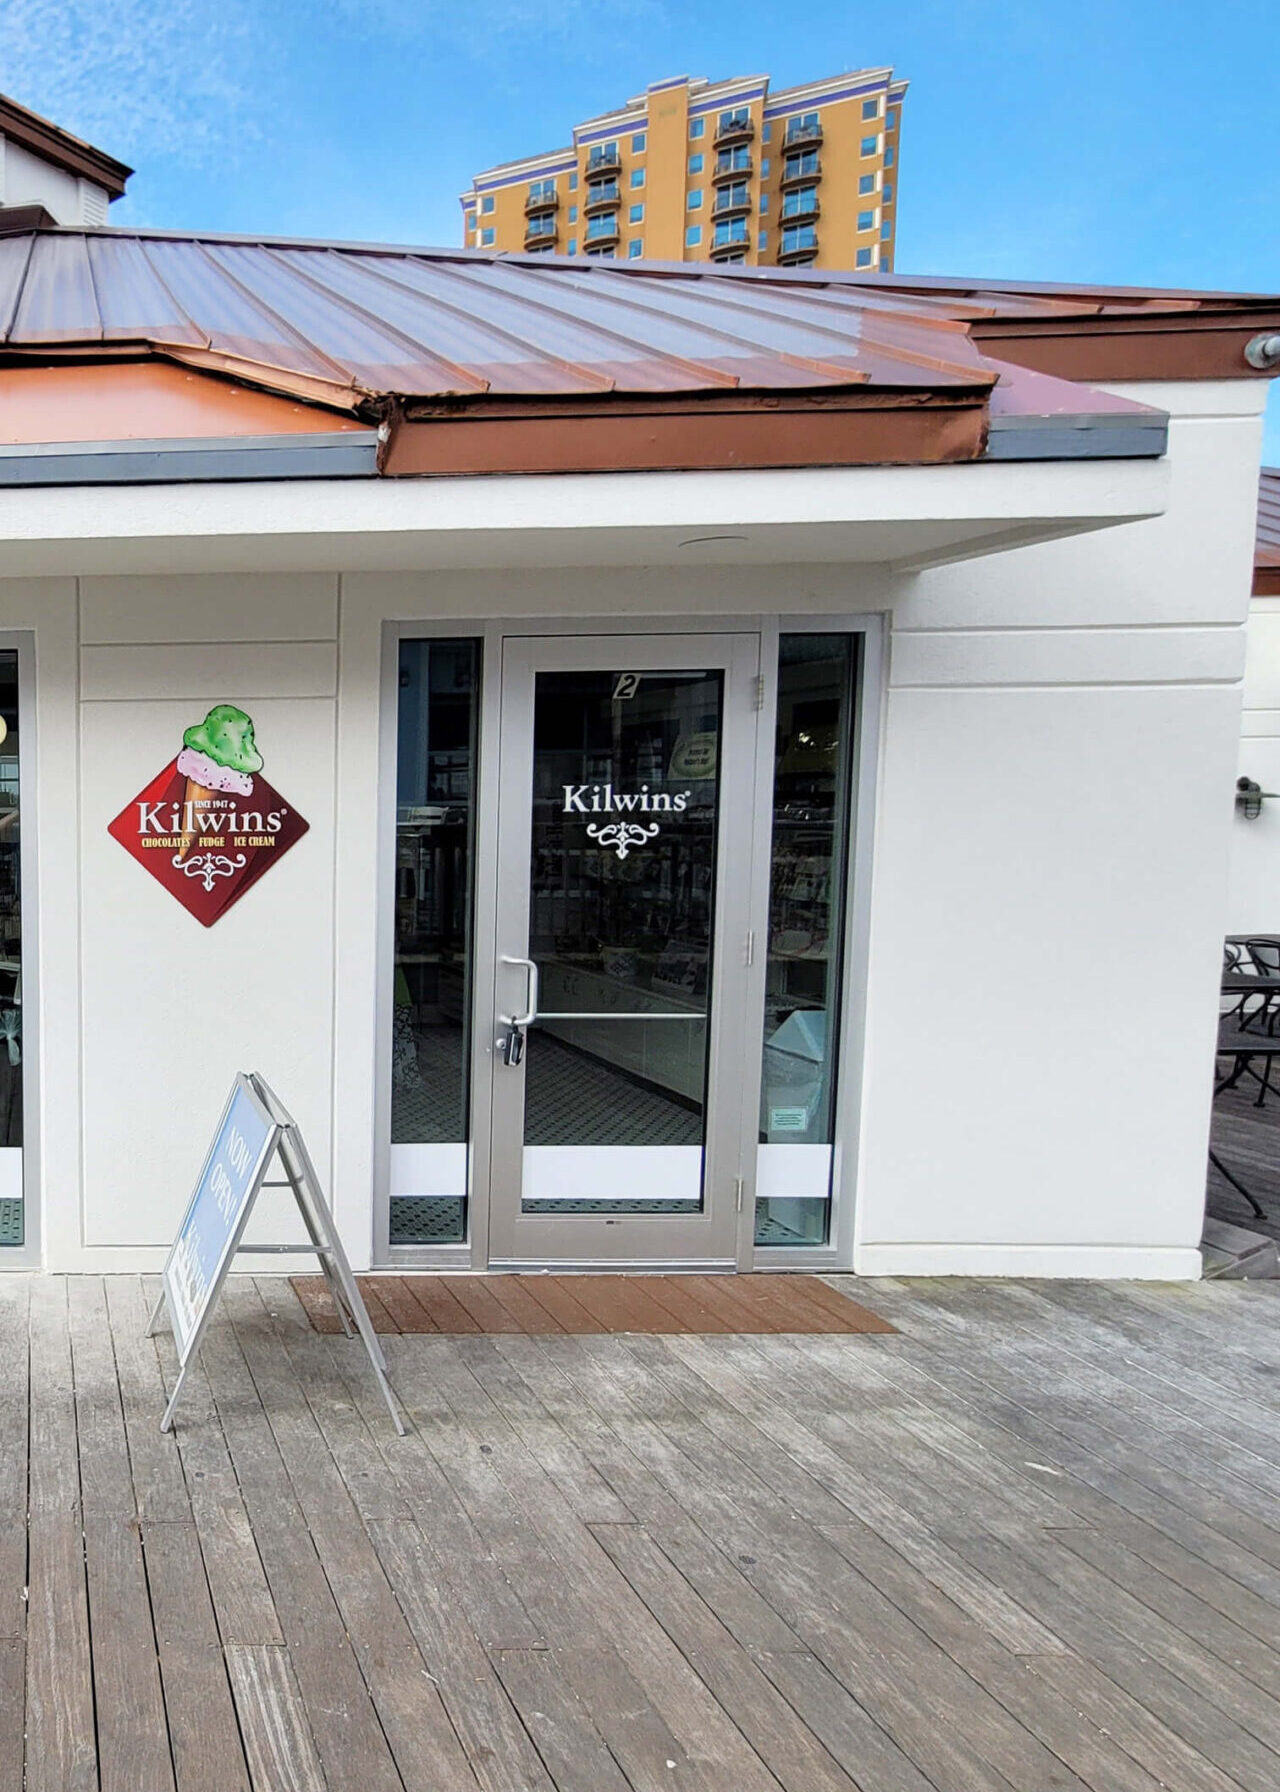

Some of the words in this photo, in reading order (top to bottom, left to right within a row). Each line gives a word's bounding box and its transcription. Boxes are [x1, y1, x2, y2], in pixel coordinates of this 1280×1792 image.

[616, 674, 636, 697] 2
[213, 800, 228, 808] 1947
[562, 784, 687, 813] Kilwins
[135, 800, 282, 834] Kilwins
[141, 837, 191, 848] CHOCOLATES
[199, 837, 225, 847] FUDGE
[234, 836, 247, 847] ICE
[248, 836, 275, 847] CREAM
[225, 1126, 253, 1179] NOW
[209, 1162, 238, 1227] OPEN!
